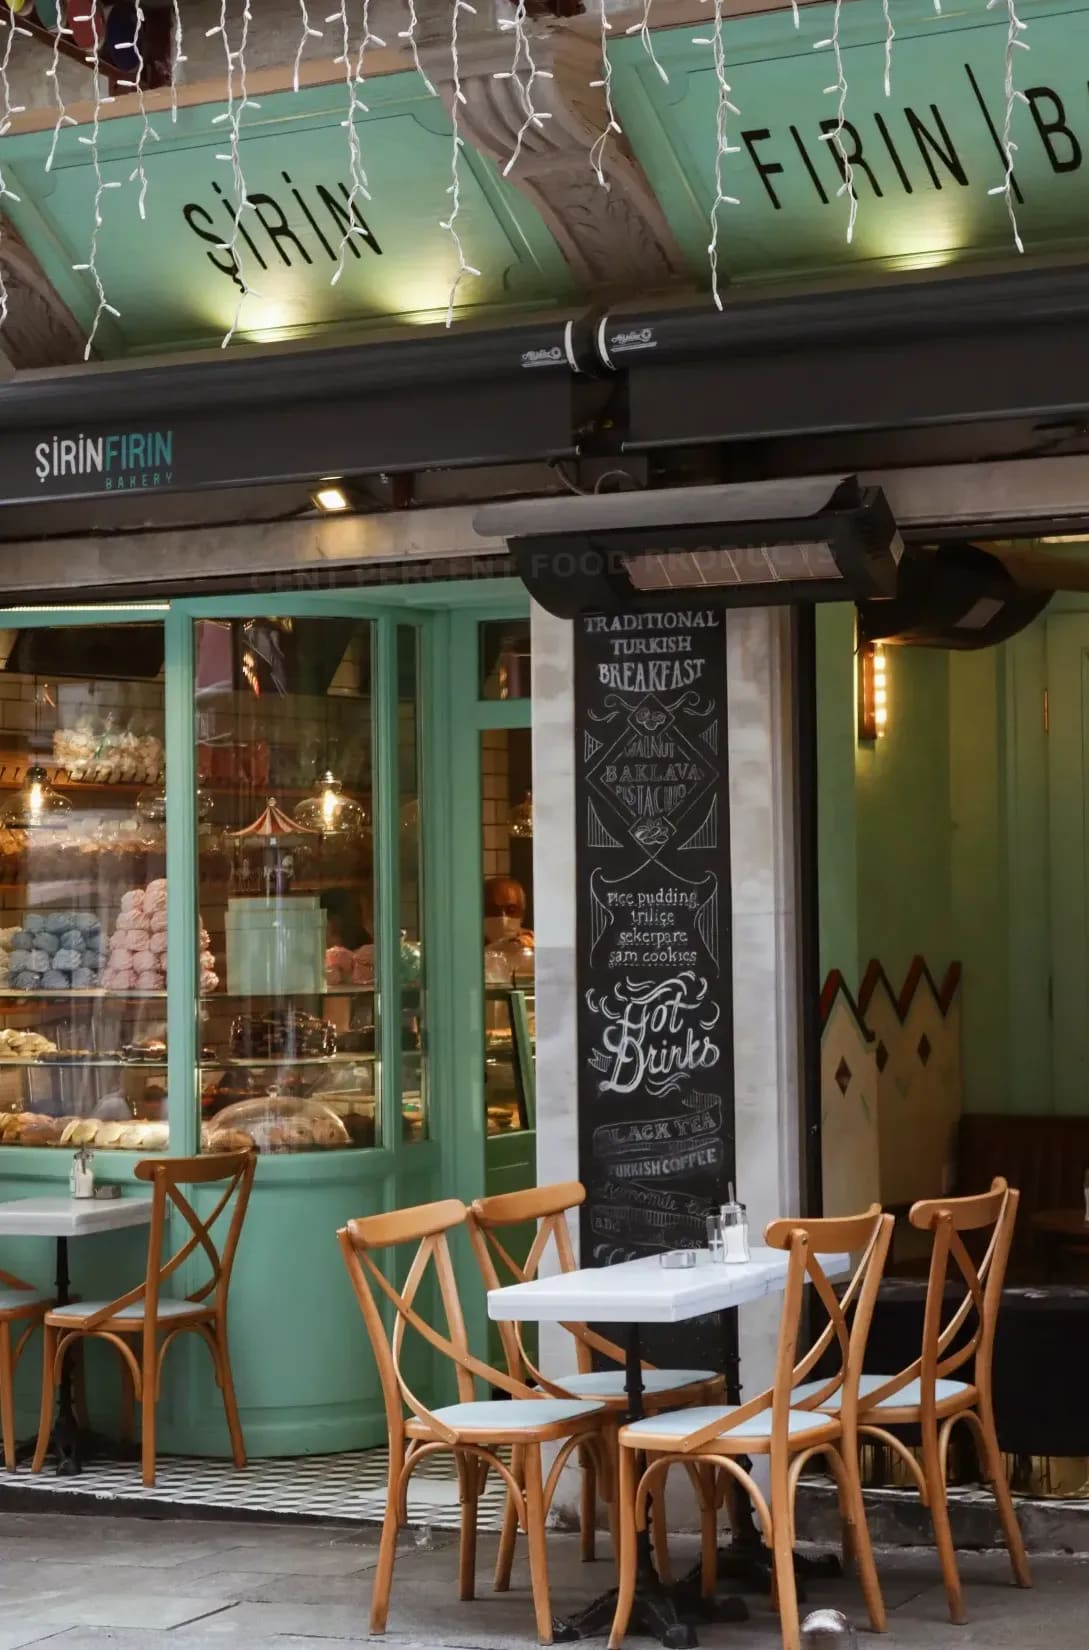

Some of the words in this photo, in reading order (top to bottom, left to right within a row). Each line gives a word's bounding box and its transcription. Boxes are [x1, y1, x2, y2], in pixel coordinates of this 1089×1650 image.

[740, 103, 969, 210] FIRIN
[1023, 80, 1089, 174] B
[105, 471, 174, 490] BAKERY
[584, 610, 719, 633] TRADITIONAL
[610, 636, 692, 655] TURKISH
[598, 659, 705, 692] BREAKFAST
[605, 763, 703, 783] BAKLAVA
[637, 887, 697, 909] pudding
[616, 990, 701, 1050] Hot
[600, 1026, 720, 1093] Drinks
[673, 1111, 717, 1138] TEA
[662, 1148, 717, 1175] COFFEE
